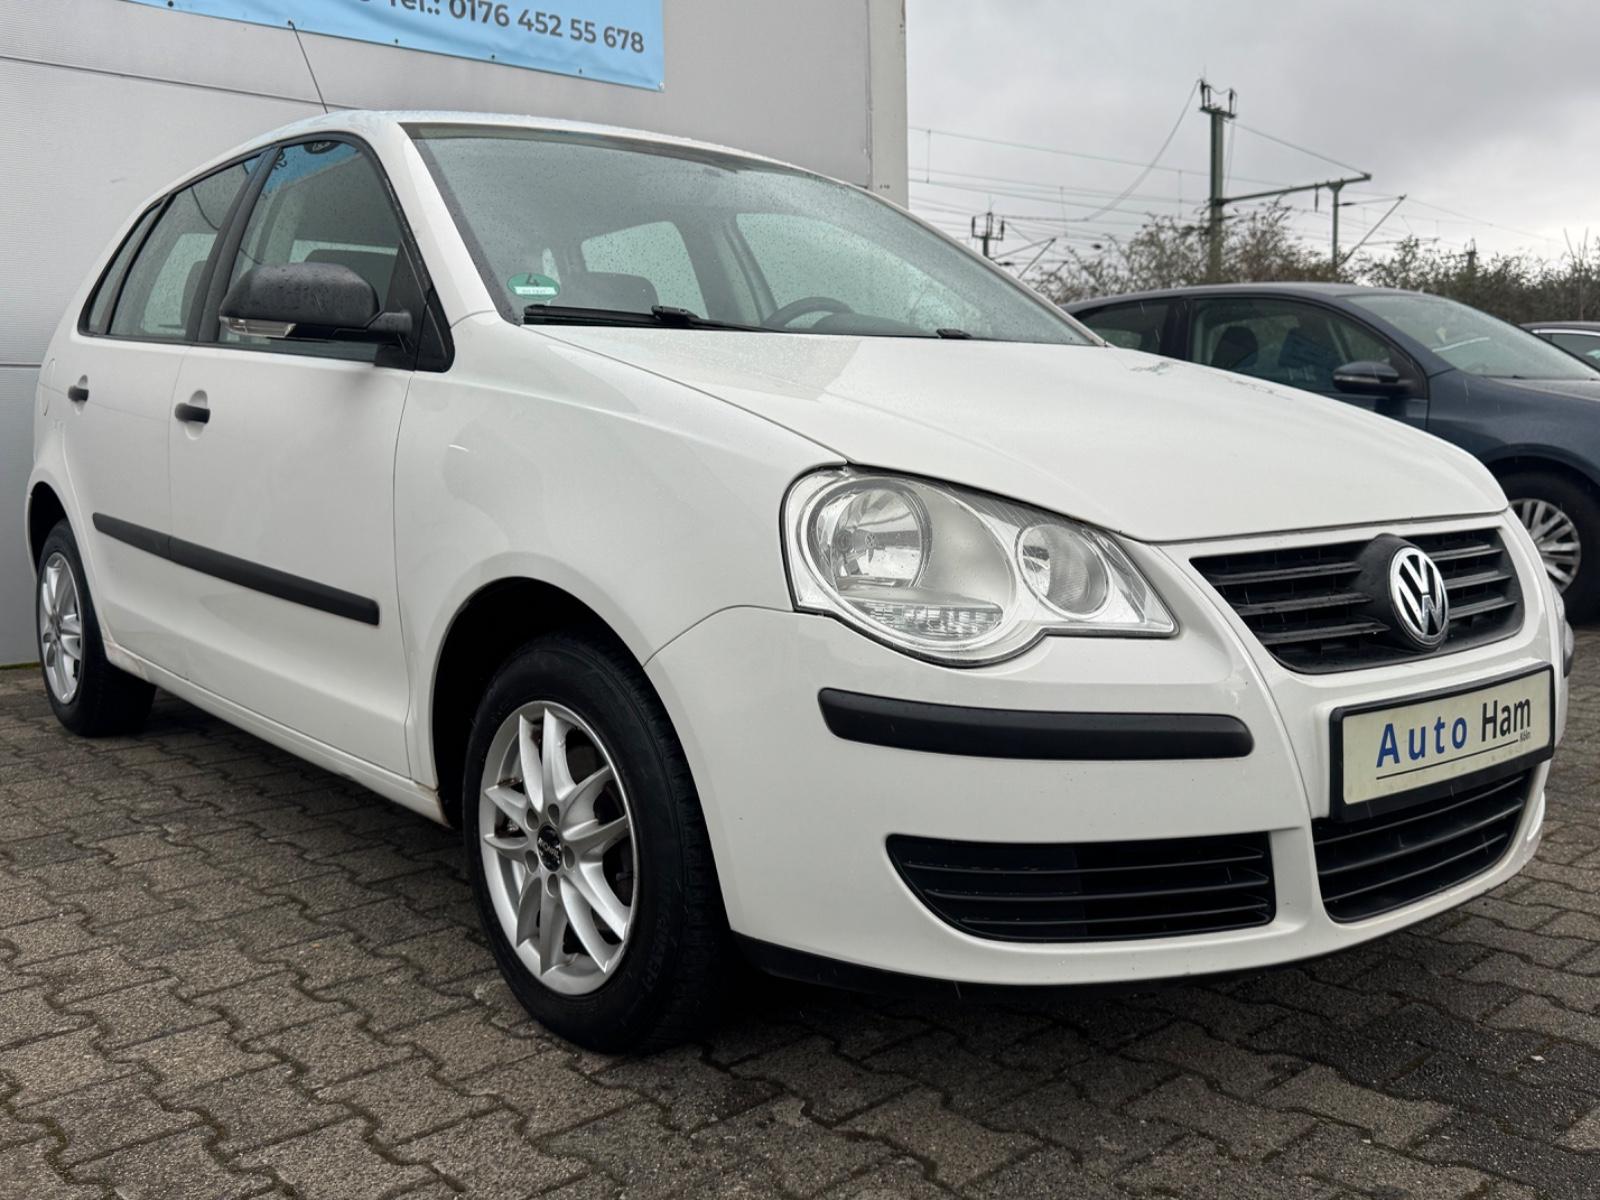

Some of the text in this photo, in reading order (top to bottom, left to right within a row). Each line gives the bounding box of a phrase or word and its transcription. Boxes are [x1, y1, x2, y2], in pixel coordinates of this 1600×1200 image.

[448, 0, 511, 28] 0176
[517, 9, 564, 38] 452
[570, 18, 598, 44] 55
[603, 26, 645, 54] 678
[1375, 698, 1531, 769] Auto Ham
